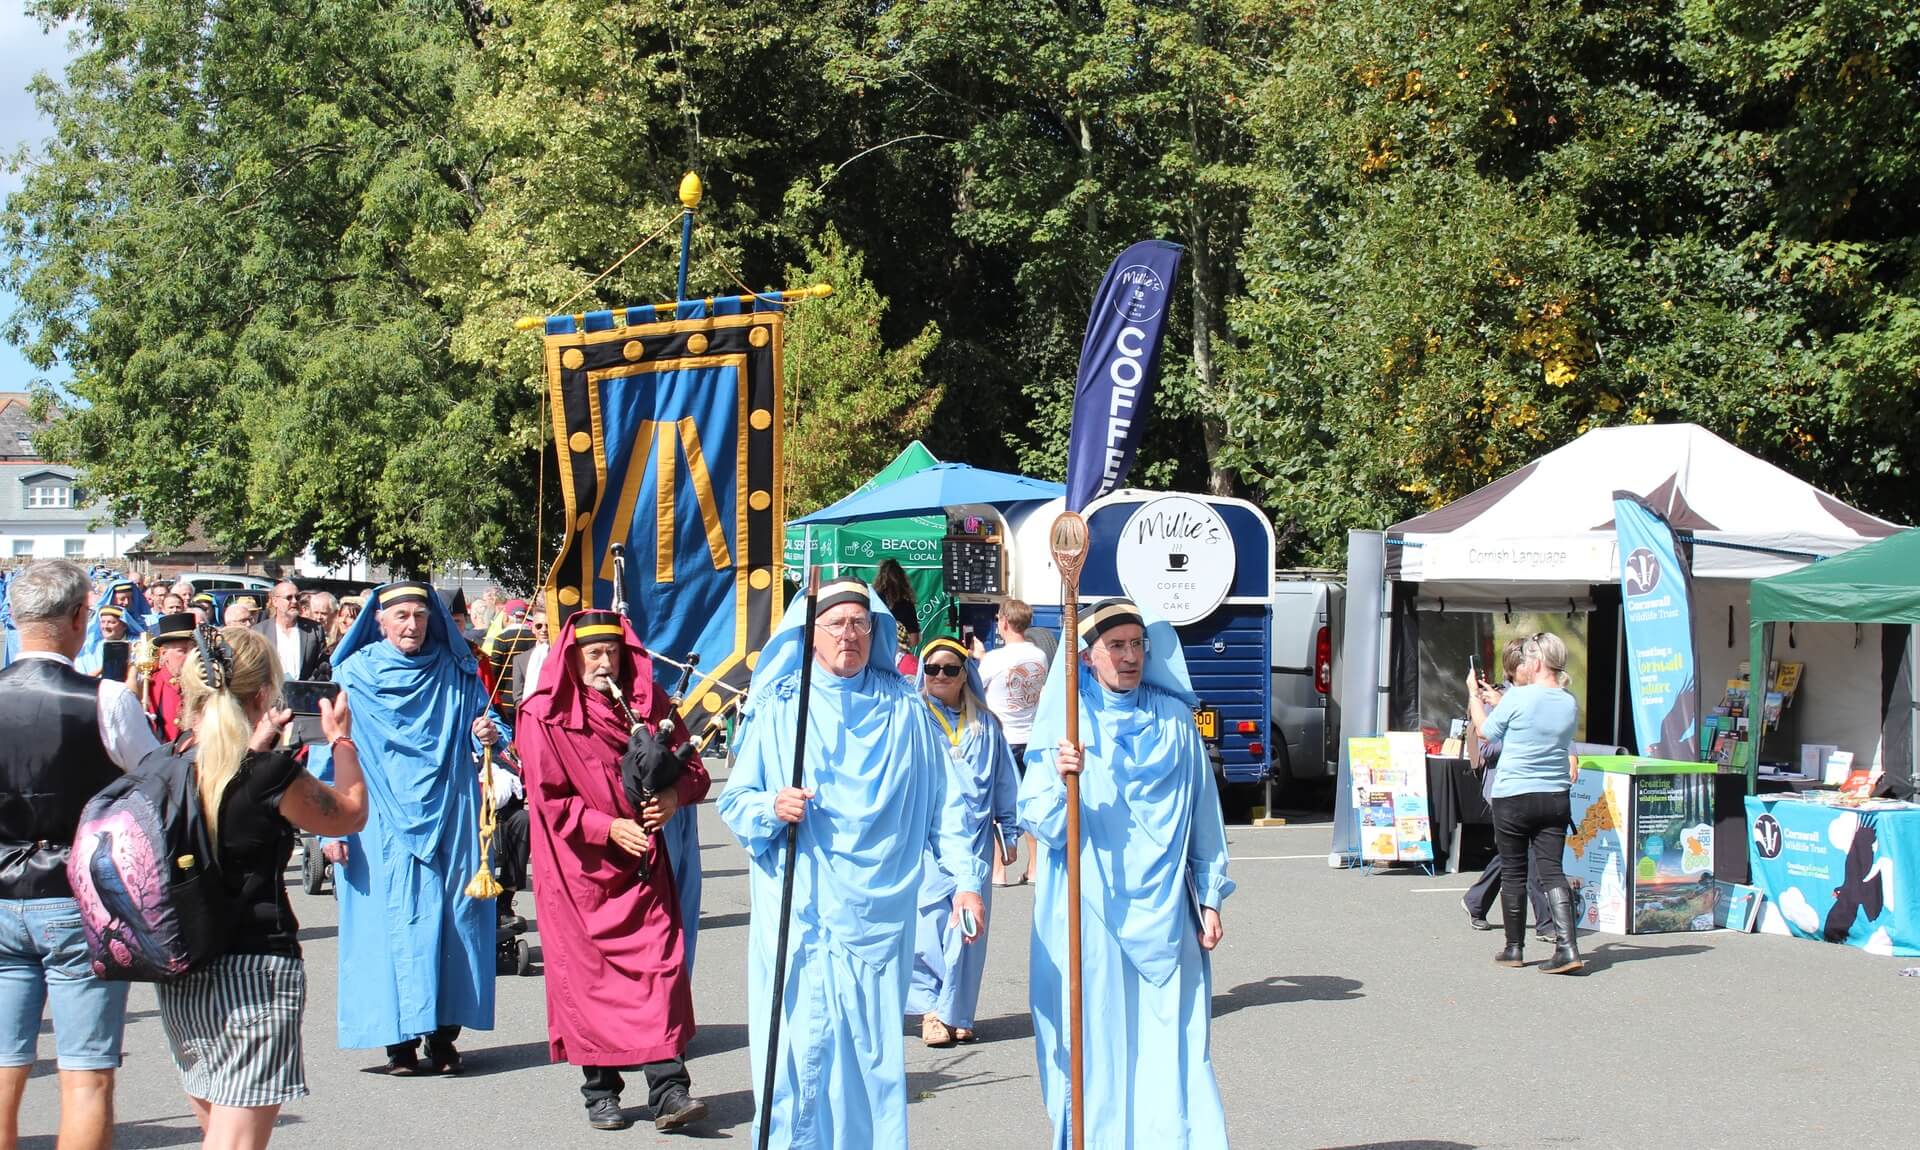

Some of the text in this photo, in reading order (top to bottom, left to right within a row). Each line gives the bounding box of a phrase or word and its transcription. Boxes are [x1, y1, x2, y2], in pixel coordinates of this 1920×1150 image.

[1122, 270, 1160, 291] Millie's
[1139, 511, 1221, 545] Millie's
[794, 539, 819, 550] SERES
[881, 538, 937, 551] BEACON
[909, 553, 937, 561] LOCAL
[1468, 548, 1567, 567] Cornish Language
[1156, 582, 1197, 590] COFFEE
[1173, 592, 1180, 600] &
[916, 595, 941, 624] CON
[1162, 602, 1191, 610] CAKE
[1639, 779, 1671, 789] Creating
[1783, 828, 1820, 842] Cornwall
